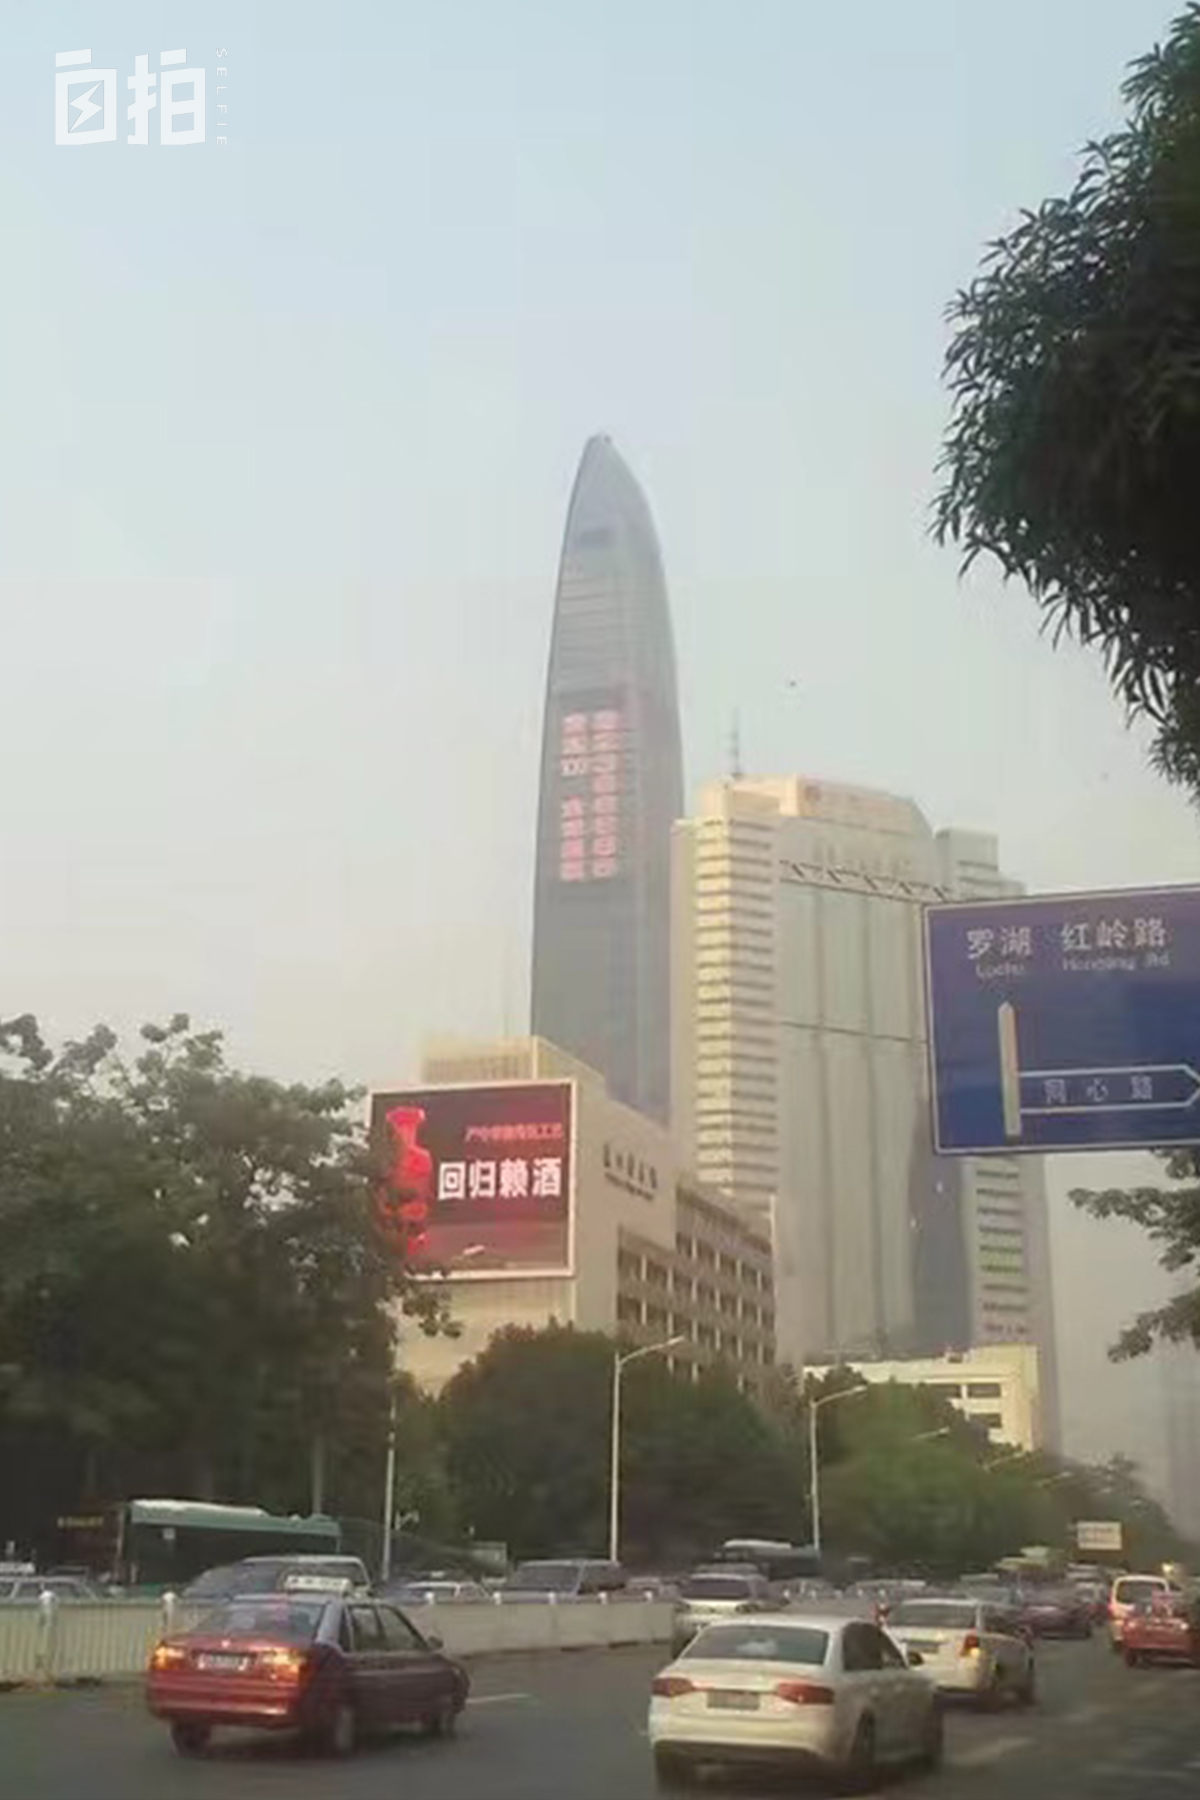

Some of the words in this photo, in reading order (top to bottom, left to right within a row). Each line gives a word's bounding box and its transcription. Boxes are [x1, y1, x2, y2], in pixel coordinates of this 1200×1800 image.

[967, 926, 1032, 959] 罗湖
[1061, 918, 1166, 951] 红岭路
[1044, 1076, 1153, 1104] 同心路
[438, 1157, 562, 1200] 回归赖酒
